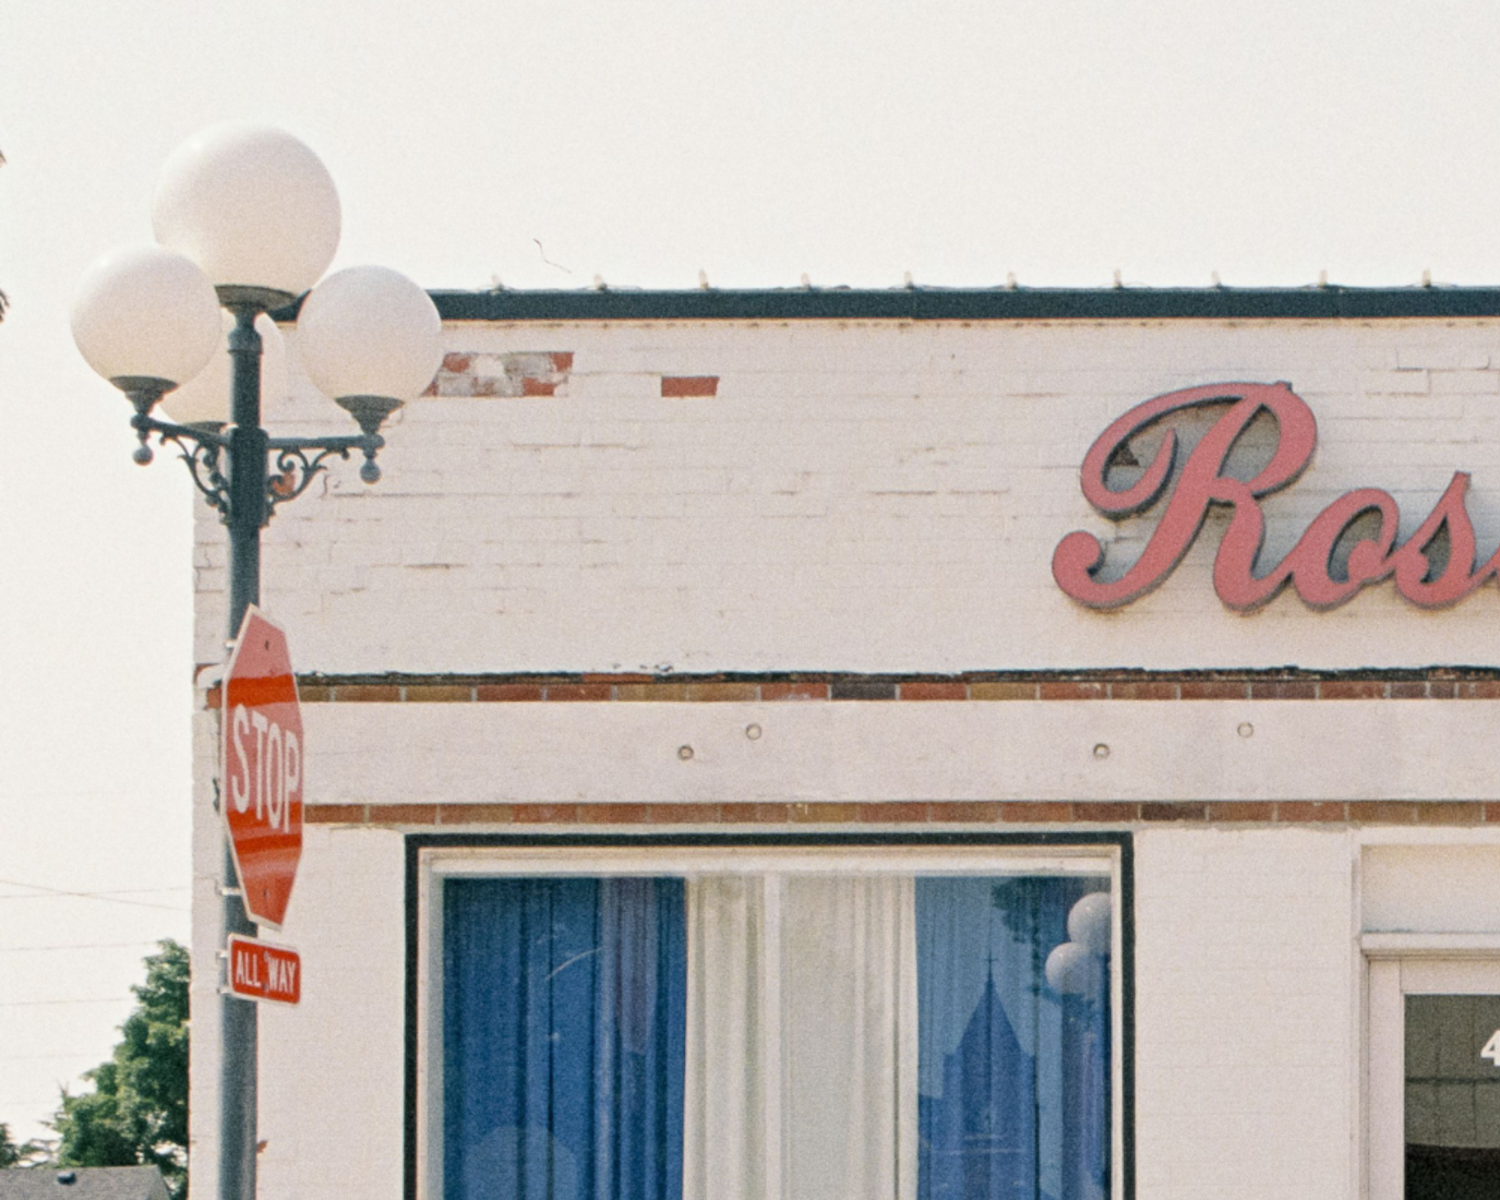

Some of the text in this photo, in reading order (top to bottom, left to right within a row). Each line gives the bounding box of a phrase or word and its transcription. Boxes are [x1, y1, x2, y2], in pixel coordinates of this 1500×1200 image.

[231, 703, 299, 833] STOP
[236, 950, 297, 994] ALL WAY
